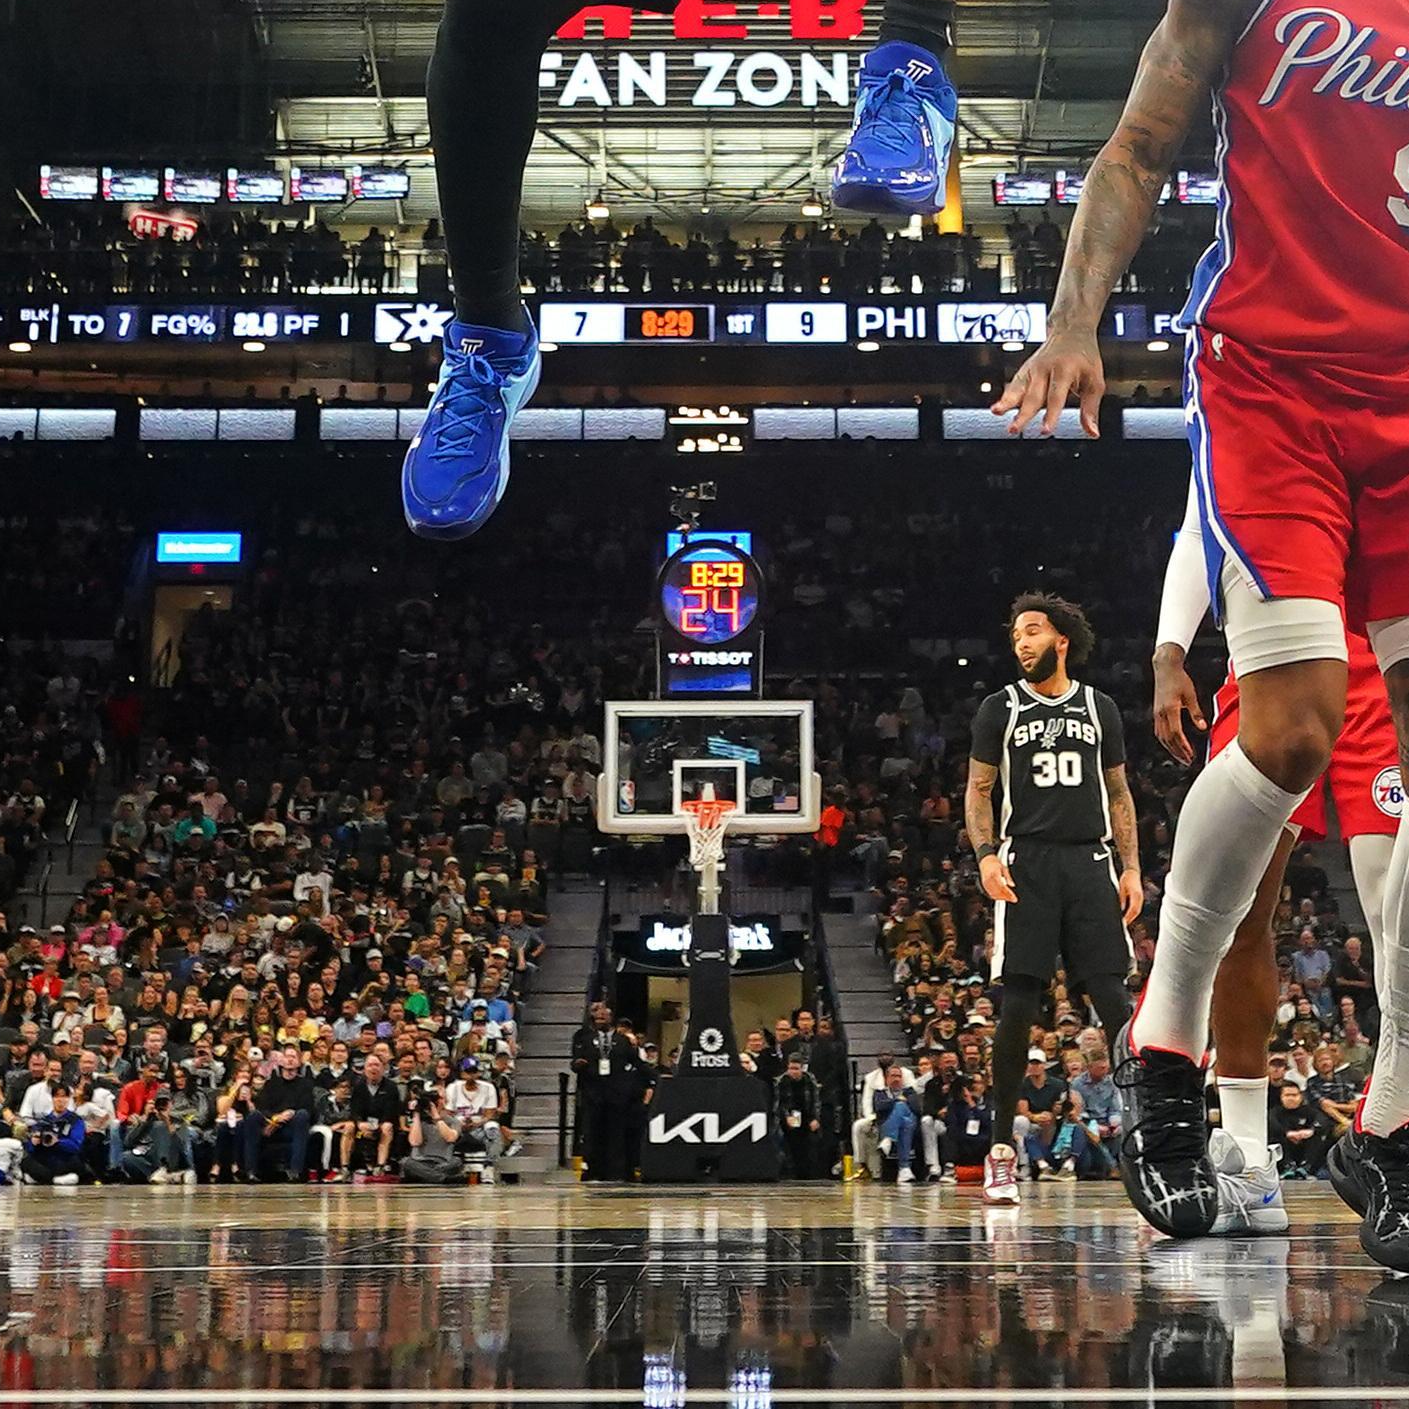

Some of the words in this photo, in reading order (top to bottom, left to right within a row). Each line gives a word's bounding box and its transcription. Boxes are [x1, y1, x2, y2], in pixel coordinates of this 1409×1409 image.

[539, 52, 667, 106] FAN
[693, 52, 866, 106] ZON
[20, 309, 50, 321] BLK
[68, 314, 105, 335] TO
[151, 314, 216, 335] FG%
[284, 315, 319, 334] PF
[340, 312, 349, 336] 1
[574, 311, 587, 336] 7
[641, 310, 694, 337] 8:29
[801, 311, 814, 336] 9
[858, 305, 925, 339] PHI
[956, 313, 1027, 341] 76ers
[691, 562, 744, 588] 8:29
[680, 587, 739, 633] 24
[691, 652, 753, 665] TISSOT
[1014, 718, 1096, 749] SPURS
[1032, 752, 1082, 787] 30
[691, 1051, 731, 1068] Frost
